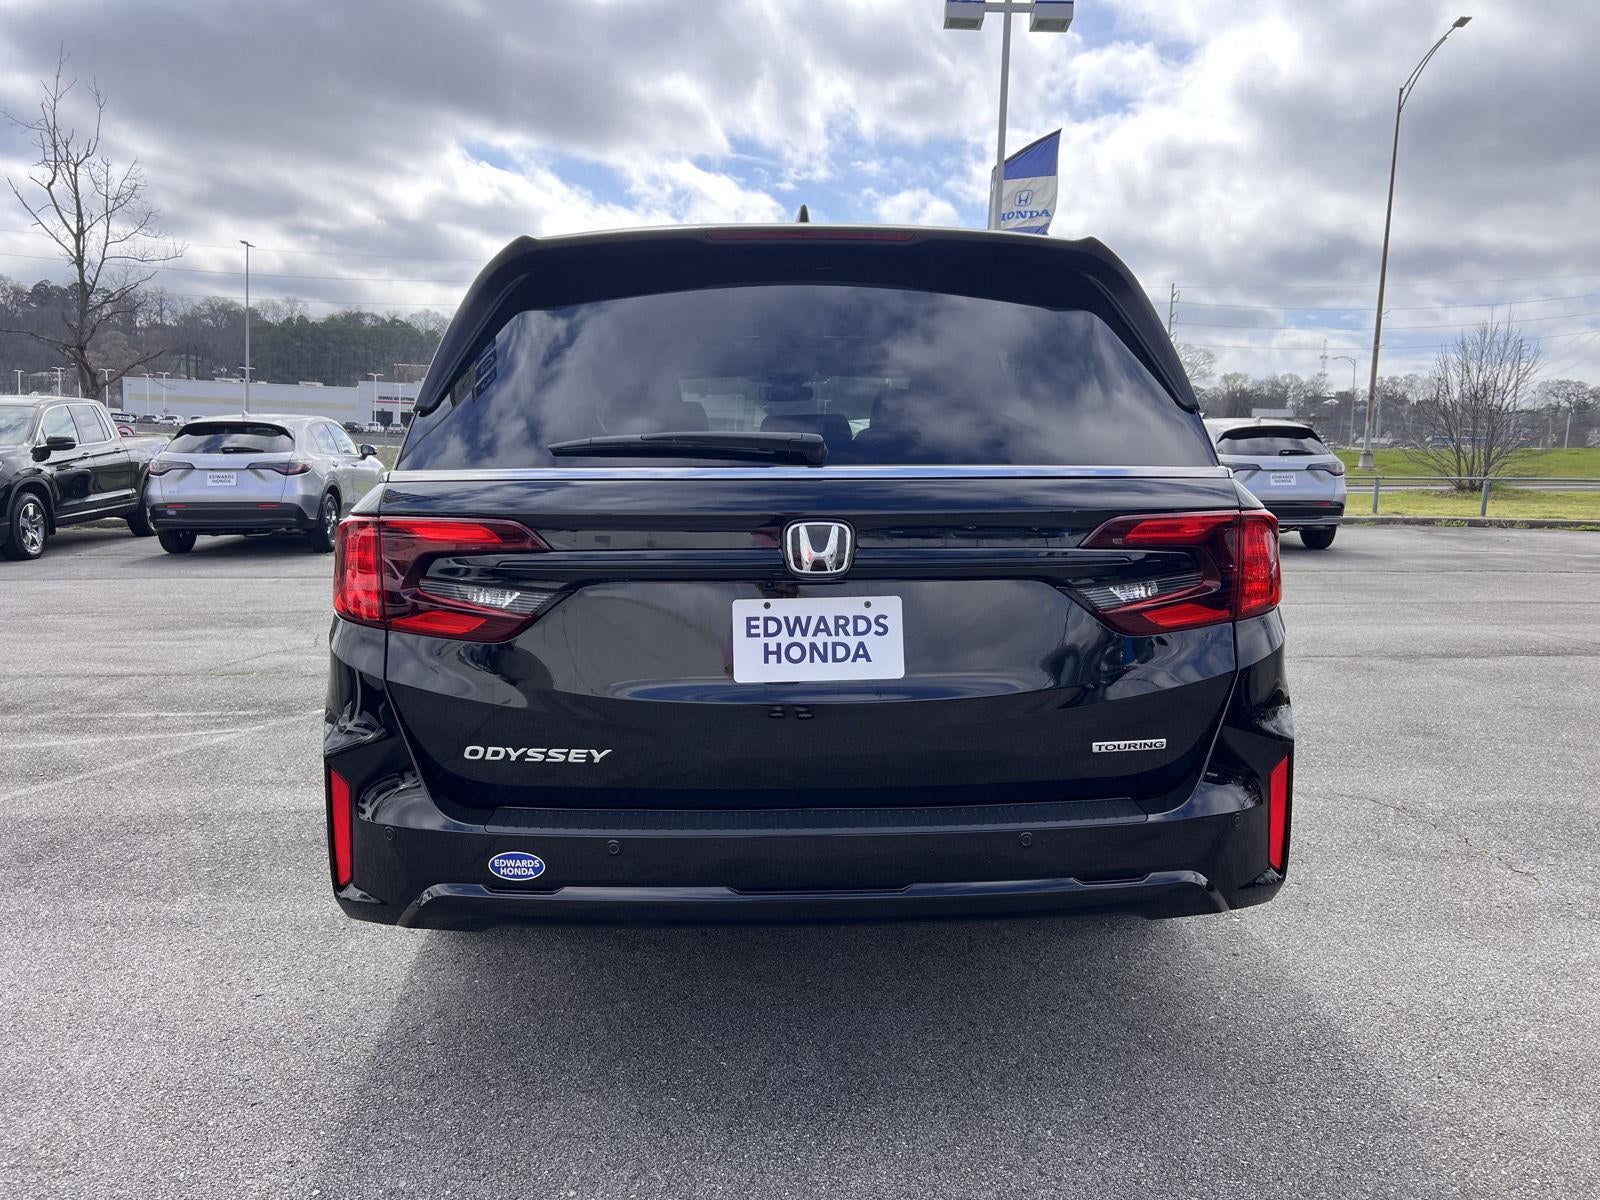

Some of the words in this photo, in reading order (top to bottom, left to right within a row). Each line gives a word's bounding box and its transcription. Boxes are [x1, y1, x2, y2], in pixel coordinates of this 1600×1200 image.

[745, 613, 890, 639] EDWARDS
[763, 640, 873, 665] HONDA
[1095, 741, 1165, 752] TOURING
[463, 745, 613, 764] ODYSSEY
[494, 858, 540, 868] EDWARDS
[500, 867, 535, 876] HONDA
